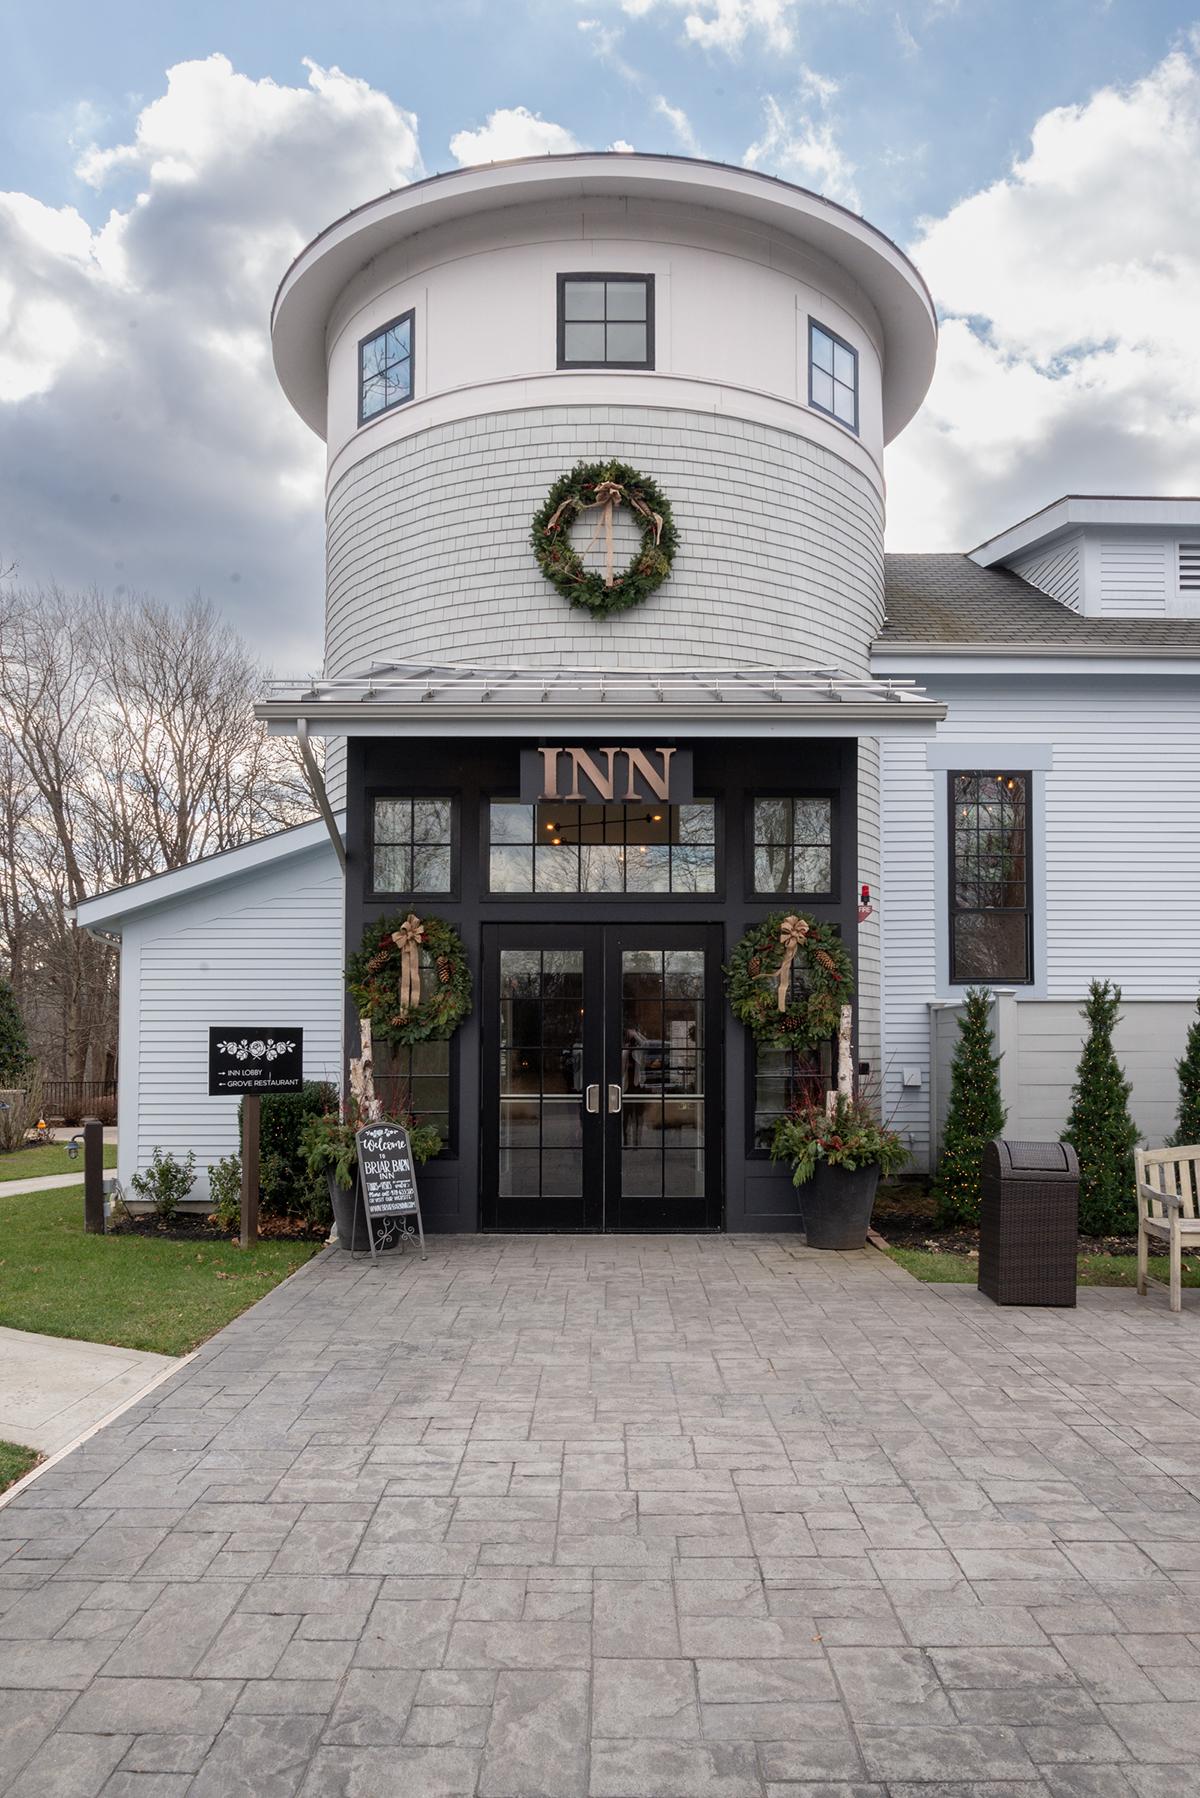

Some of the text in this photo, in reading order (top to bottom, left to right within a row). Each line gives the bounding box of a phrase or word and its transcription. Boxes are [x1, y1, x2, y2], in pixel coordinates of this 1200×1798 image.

[537, 747, 677, 800] INN
[360, 1137, 406, 1152] Welcome
[364, 1158, 410, 1174] BRIAR BARN
[379, 1172, 395, 1180] INN
